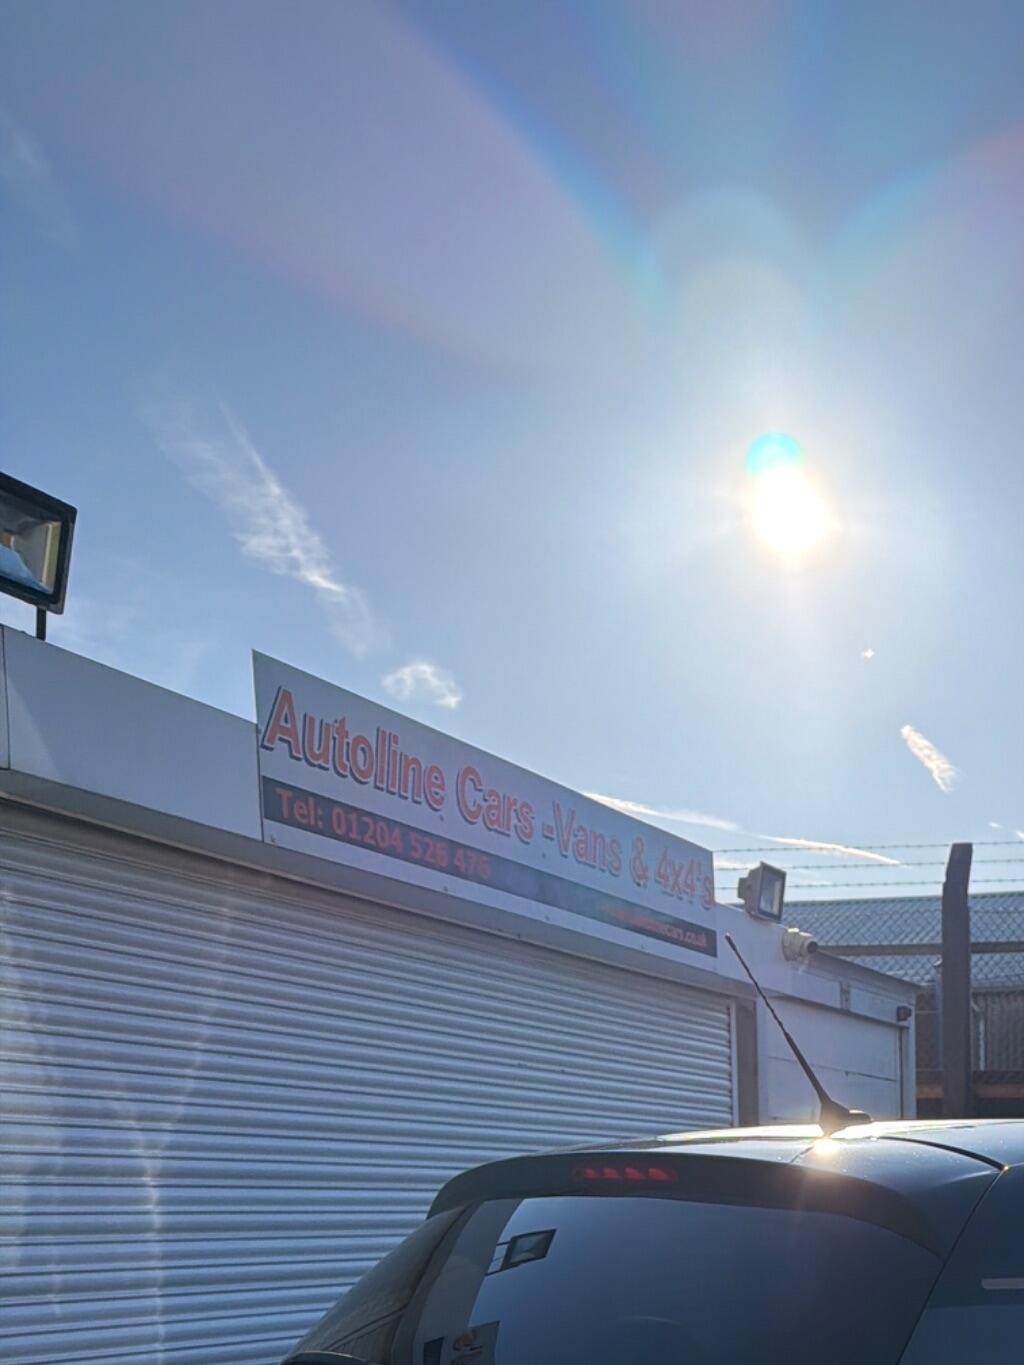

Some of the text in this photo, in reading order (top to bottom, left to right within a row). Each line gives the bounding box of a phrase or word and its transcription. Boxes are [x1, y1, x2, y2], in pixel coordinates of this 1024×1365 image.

[261, 686, 446, 811] Autoline
[456, 765, 536, 845] Cars
[630, 835, 649, 887] &
[275, 788, 323, 829] Tel:
[331, 806, 403, 852] 01204
